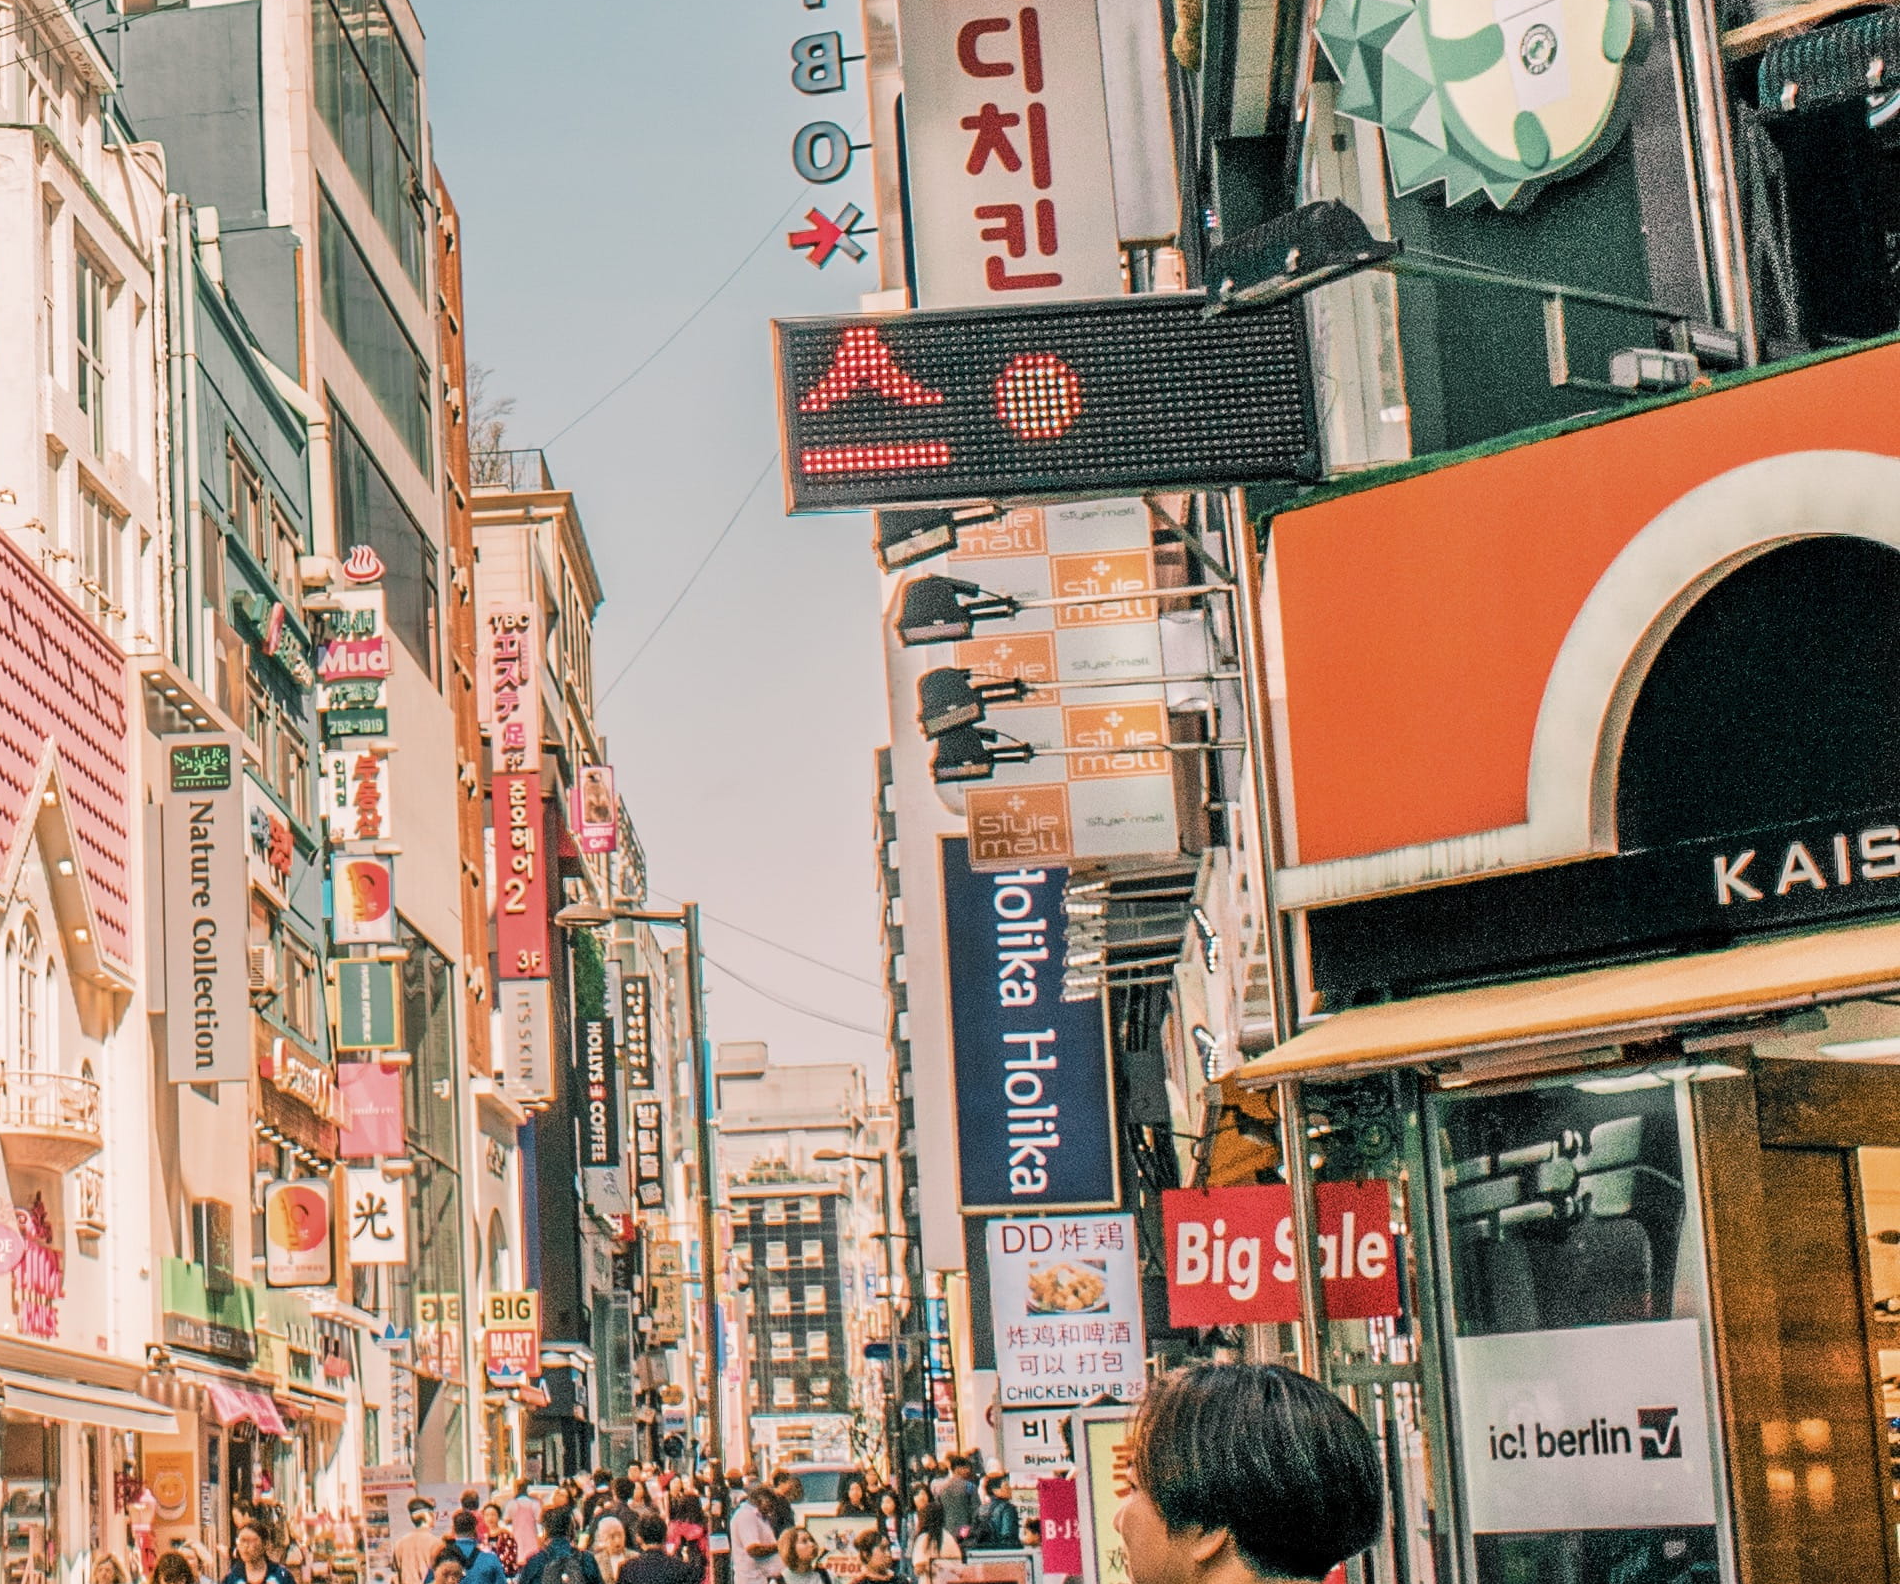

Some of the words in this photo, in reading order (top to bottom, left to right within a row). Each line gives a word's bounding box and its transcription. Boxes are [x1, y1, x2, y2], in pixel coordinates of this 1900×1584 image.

[317, 643, 390, 673] Mud
[328, 718, 384, 736] 752-1919
[173, 778, 230, 789] collection
[352, 755, 382, 838] 부동산
[189, 801, 214, 908] Nature
[978, 832, 1062, 857] mall
[504, 879, 527, 914] 2
[517, 950, 541, 970] 3F
[192, 919, 219, 1072] Collection
[587, 1021, 606, 1084] HOLLYS
[1001, 1028, 1061, 1195] Holika
[589, 1100, 608, 1163] COFFEE
[354, 1192, 394, 1241] 光
[1176, 1220, 1260, 1302] Big
[492, 1297, 531, 1320] BIG
[490, 1332, 533, 1358] MART
[1006, 1322, 1131, 1348] 炸鸡和啤酒
[1017, 1353, 1067, 1378] 可以
[1076, 1350, 1125, 1374] 打包
[1489, 1422, 1527, 1460] ic!
[1535, 1417, 1633, 1459] berlin
